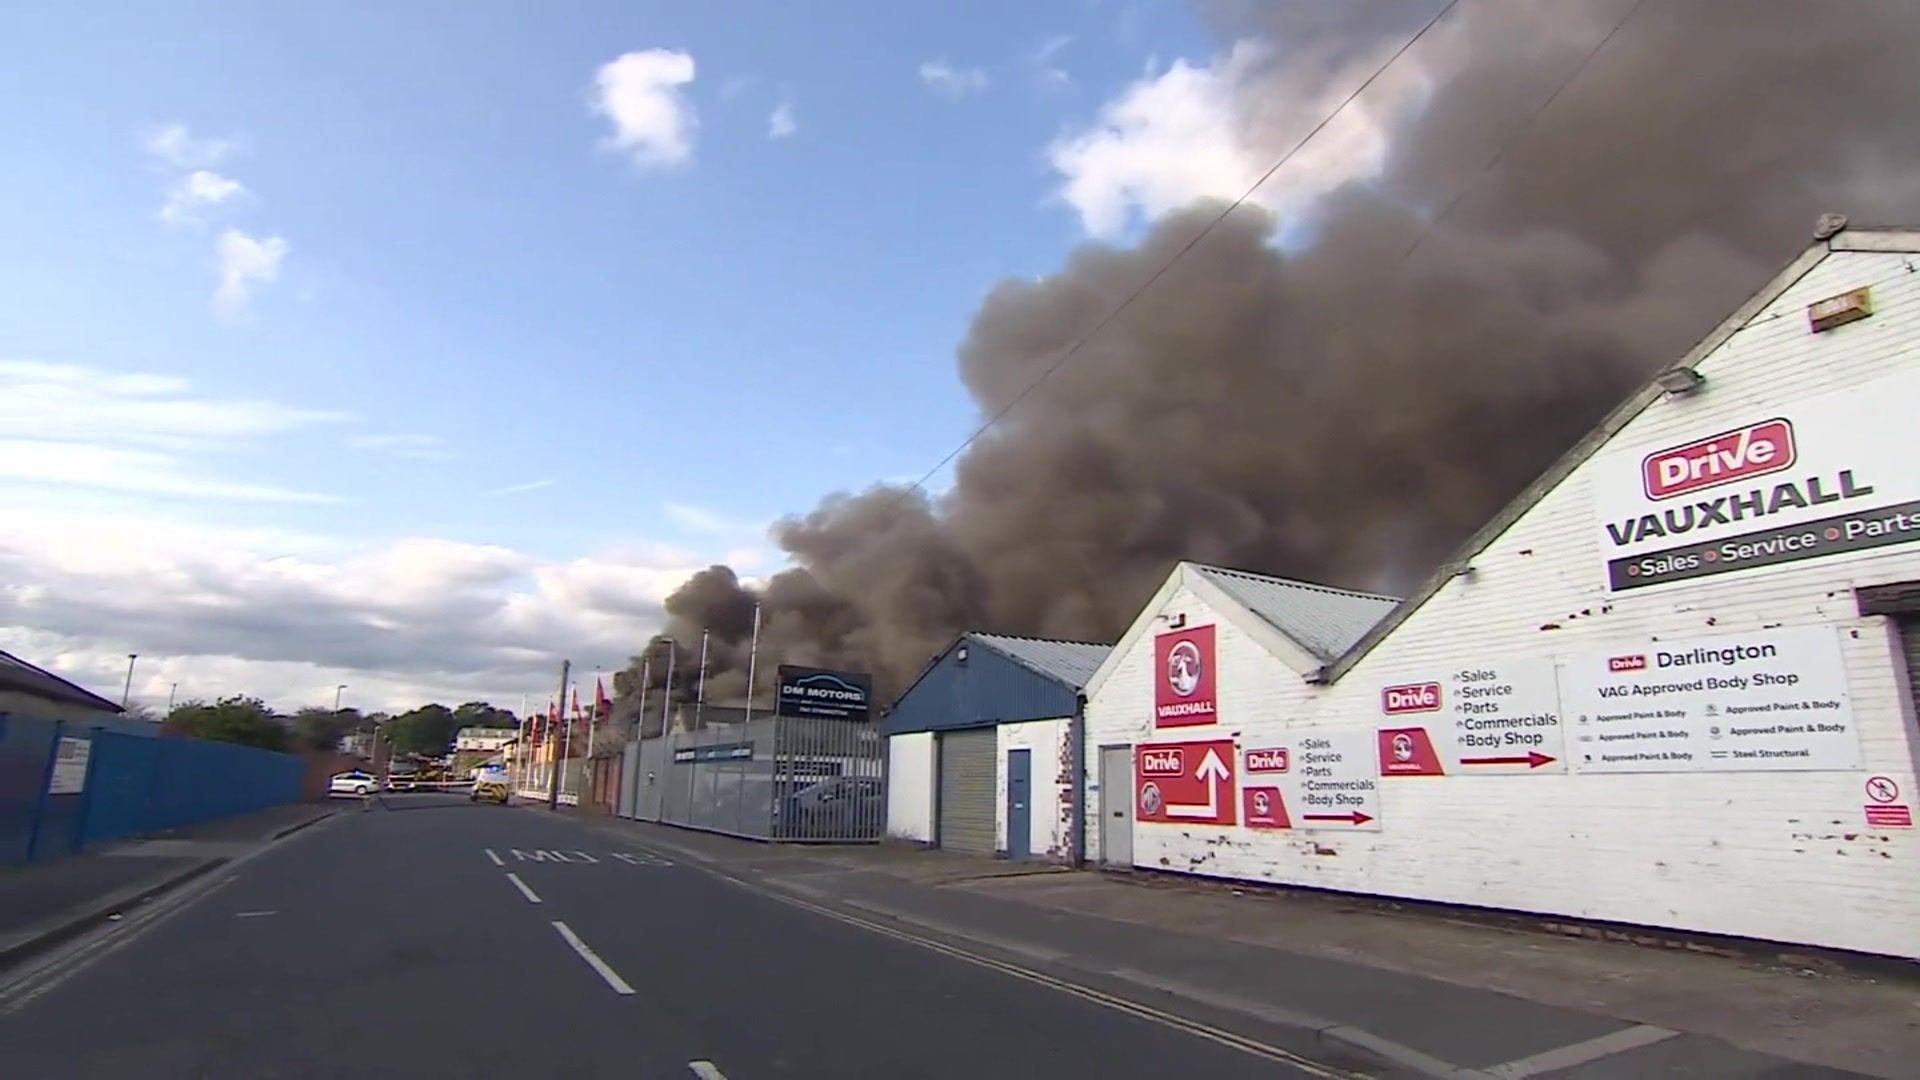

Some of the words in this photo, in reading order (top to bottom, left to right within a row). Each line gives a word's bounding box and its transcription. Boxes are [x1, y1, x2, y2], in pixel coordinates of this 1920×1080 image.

[1658, 430, 1776, 488] Drive
[1606, 469, 1873, 546] VAUXHALL
[1640, 552, 1699, 577] Sales
[1721, 530, 1817, 563] Service
[1845, 511, 1920, 540] Parts
[1612, 656, 1643, 669] Drive
[1657, 643, 1777, 668] Darlington
[1461, 669, 1497, 683] Sales
[783, 685, 804, 695] DM
[807, 688, 861, 701] MOTORS
[1462, 684, 1512, 698] Service
[1598, 684, 1628, 699] VAG
[1632, 679, 1703, 697] Approved
[1706, 675, 1748, 691] Body
[1752, 672, 1799, 687] Shop
[1388, 686, 1434, 709] Drive
[1158, 701, 1215, 717] VAUXHALL
[1463, 701, 1499, 714] Parts
[1464, 713, 1557, 731] Commercials
[1305, 738, 1331, 750] Sales
[1466, 733, 1500, 749] Body
[1504, 731, 1543, 747] Shop
[1145, 751, 1179, 770] Drive
[1249, 750, 1284, 768] Drive
[1305, 752, 1342, 764] Service
[1759, 749, 1809, 758] Structural
[1306, 766, 1332, 777] Parts
[1307, 779, 1375, 791] Commercials
[1308, 794, 1333, 808] Body
[1335, 793, 1364, 807] Shop
